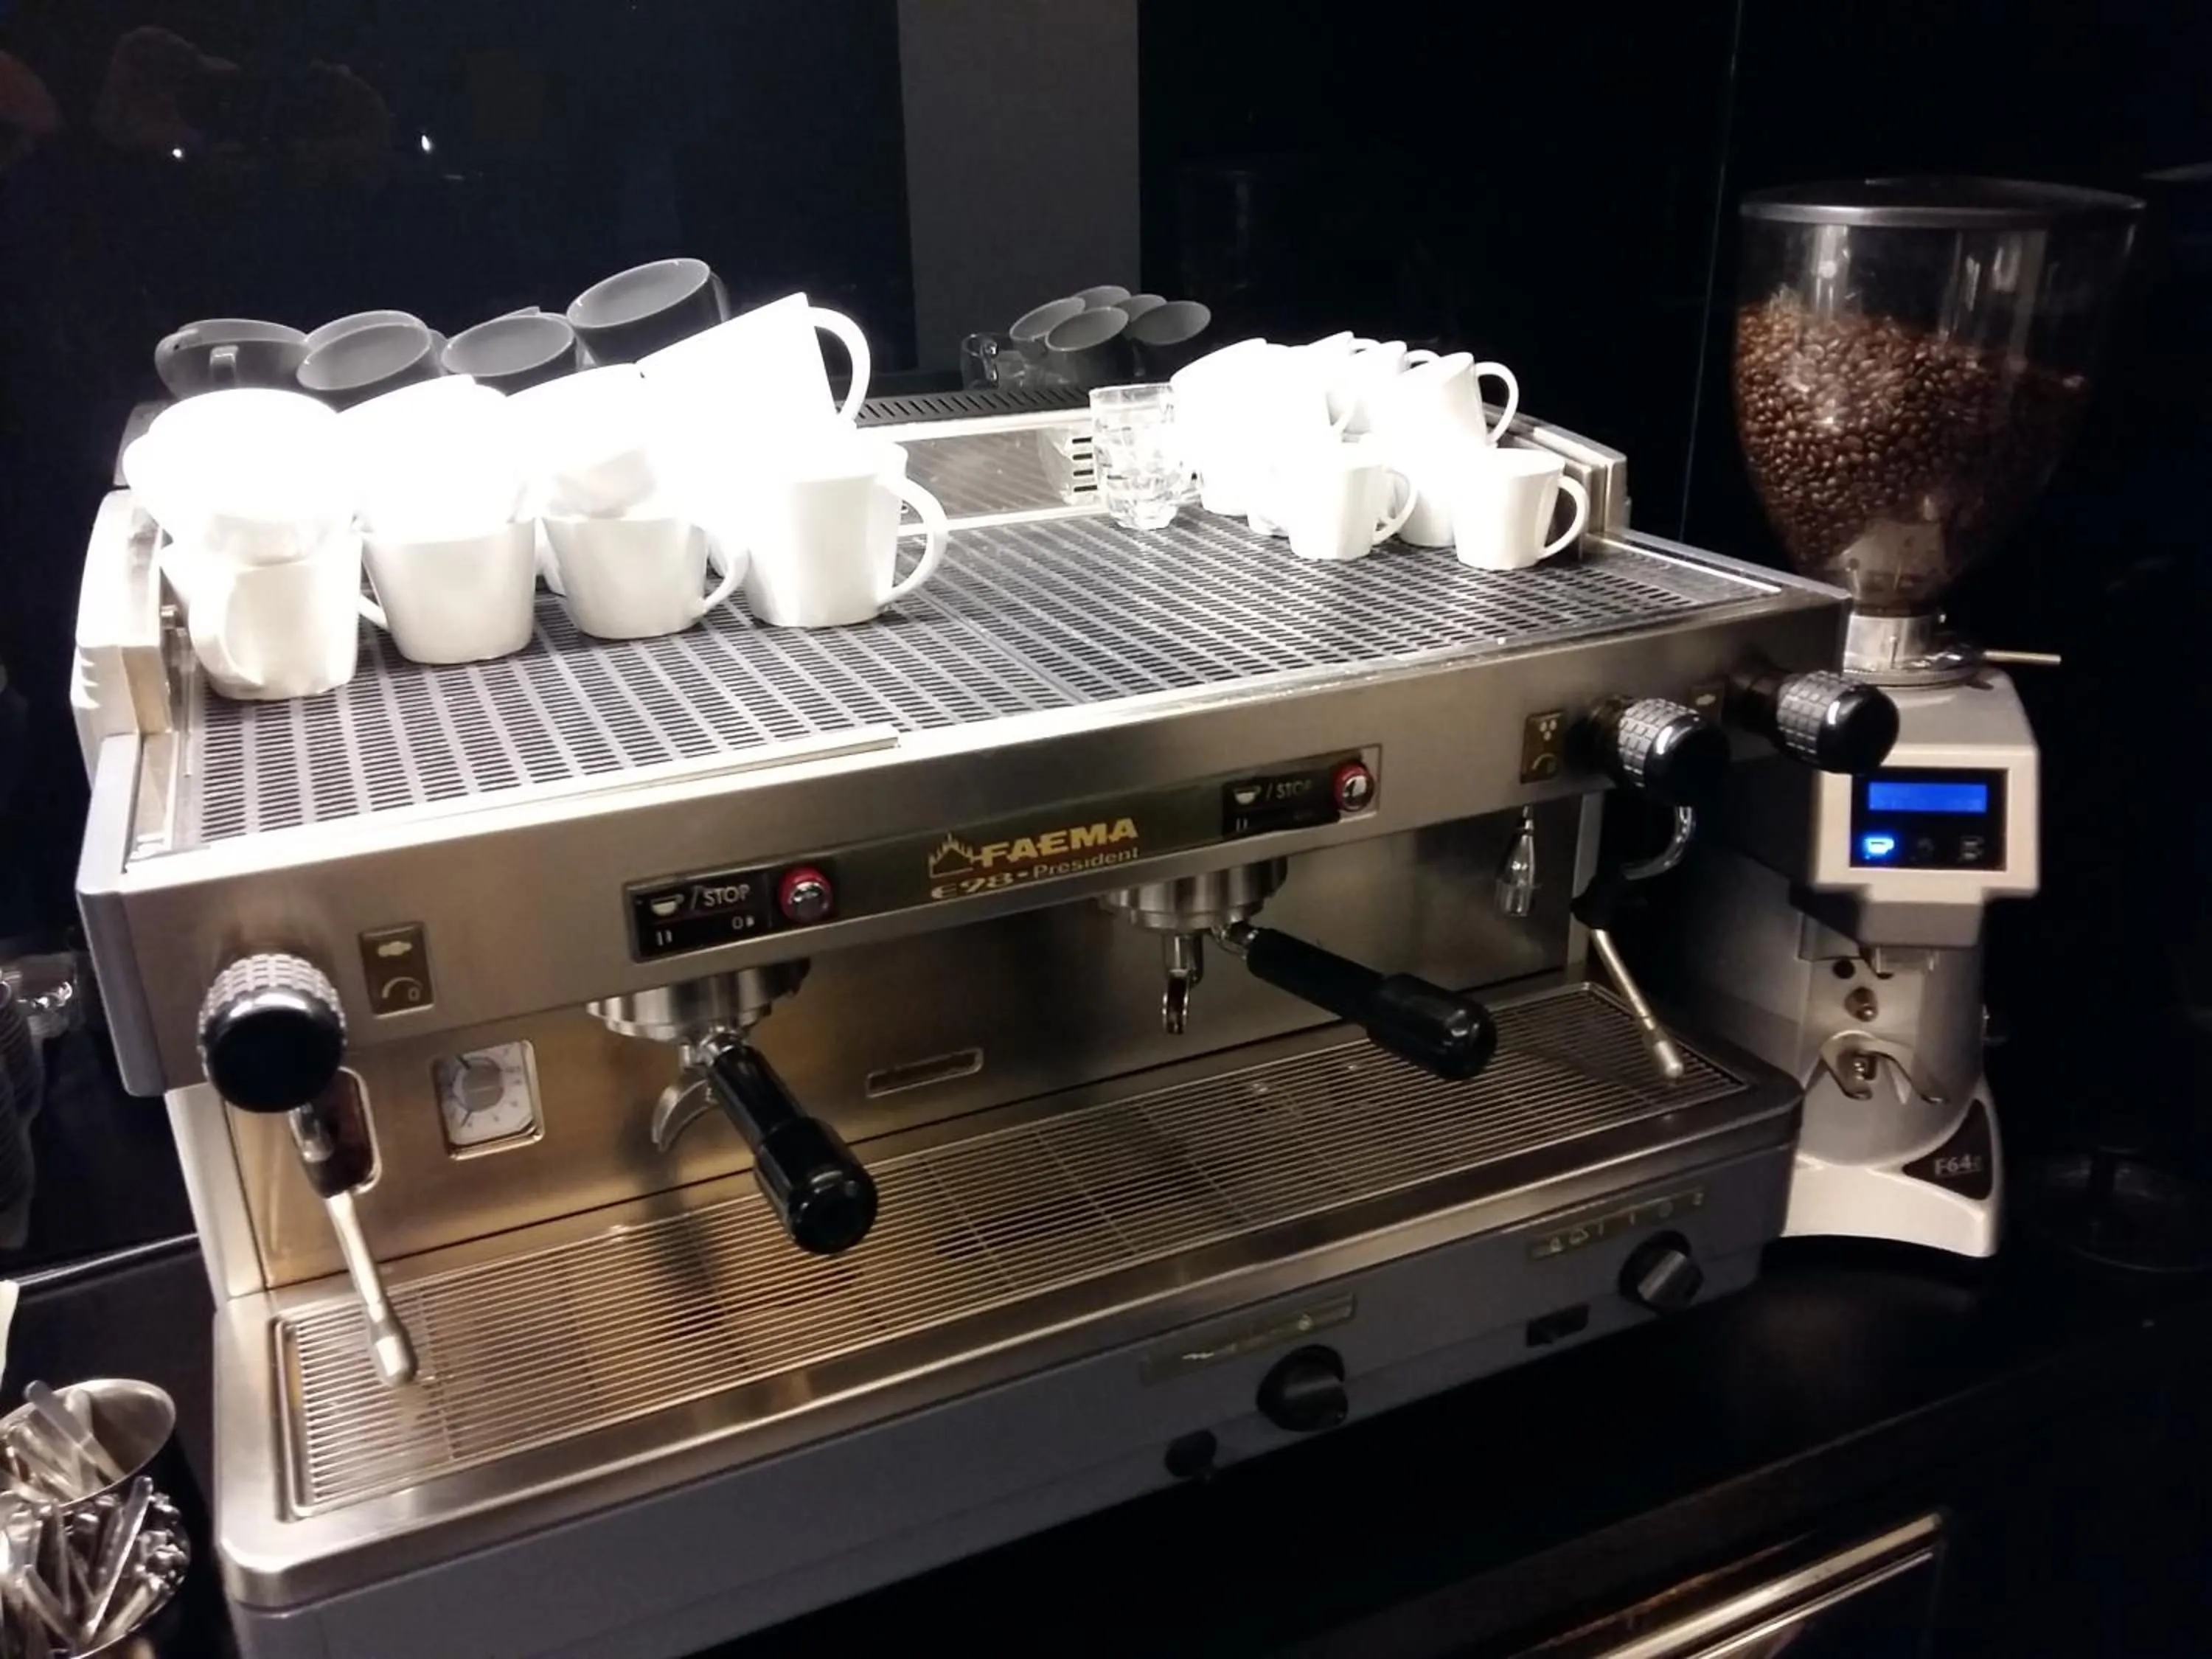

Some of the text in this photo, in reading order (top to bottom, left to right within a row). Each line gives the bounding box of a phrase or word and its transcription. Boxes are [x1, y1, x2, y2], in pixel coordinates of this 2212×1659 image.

[978, 817, 1139, 868] FAEMA
[1033, 846, 1141, 879] President
[703, 884, 751, 907] STOP
